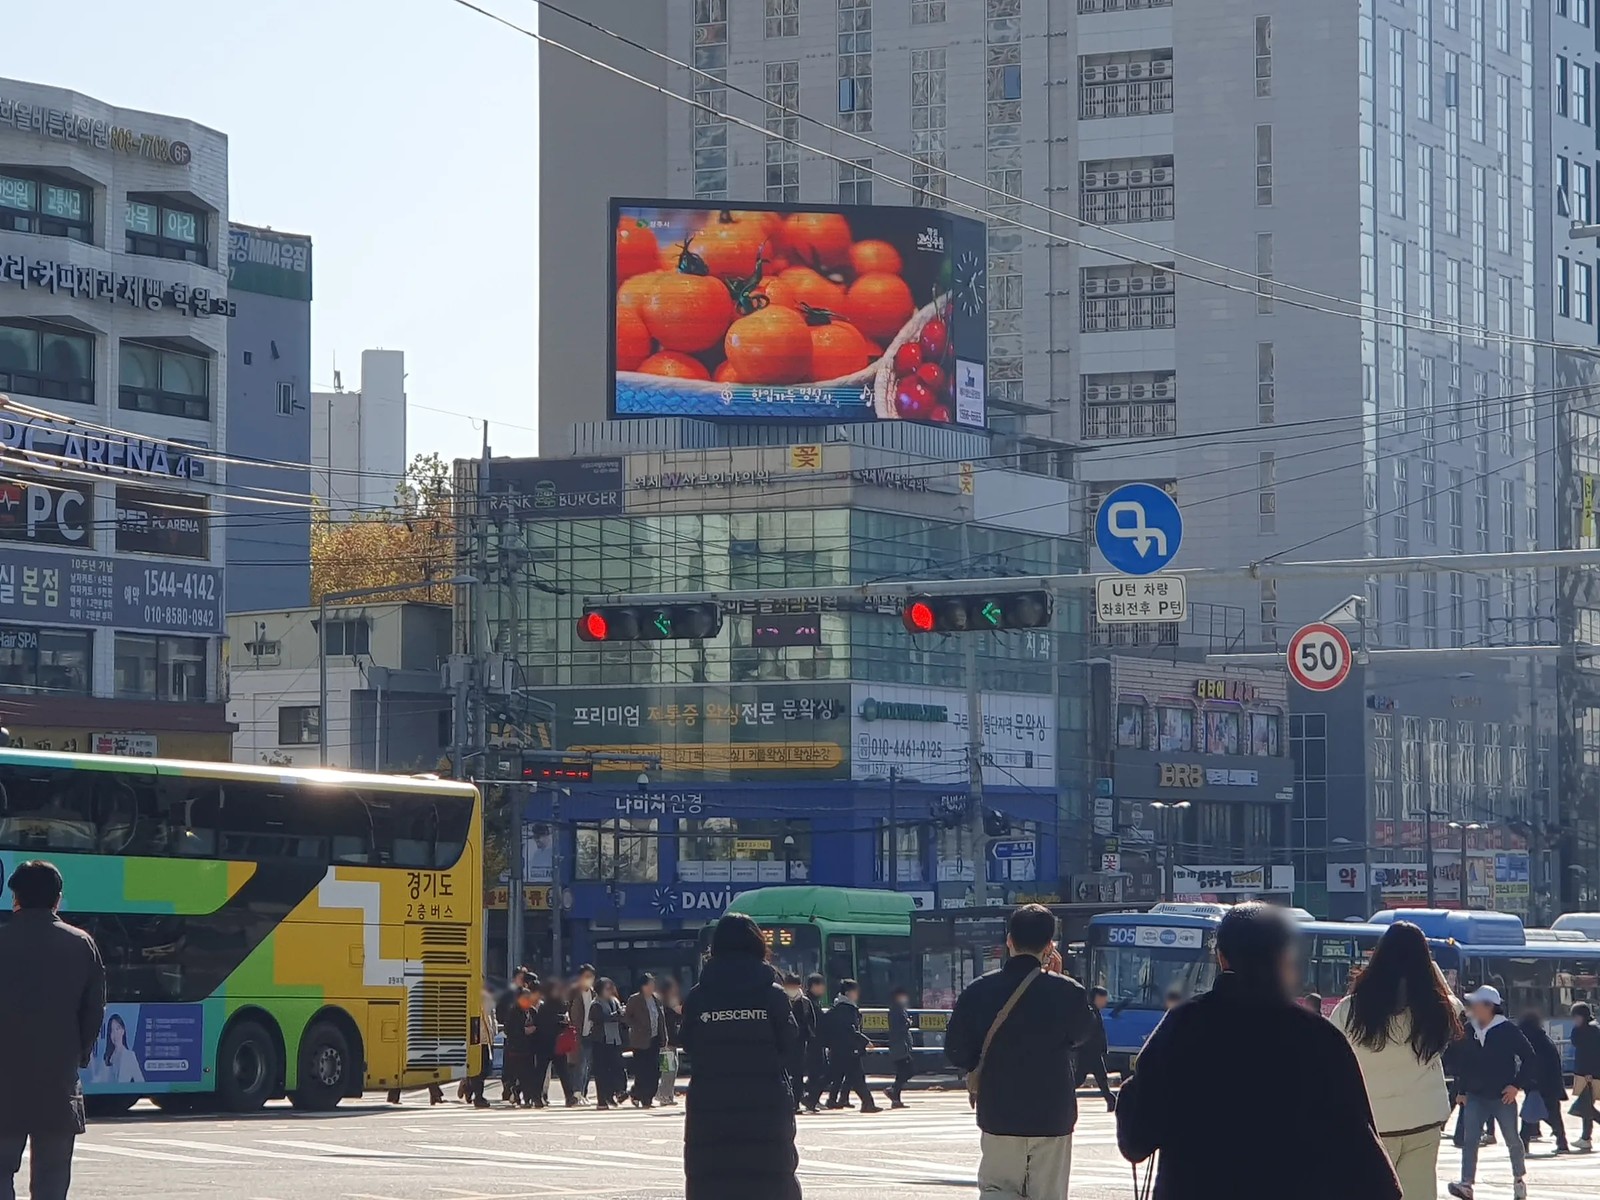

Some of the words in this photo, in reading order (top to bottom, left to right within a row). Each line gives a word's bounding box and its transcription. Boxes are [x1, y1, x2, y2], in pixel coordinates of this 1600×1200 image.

[173, 144, 188, 163] 6F
[48, 187, 81, 216] 교통사고
[168, 211, 196, 243] 야간
[64, 428, 171, 477] ARENA
[792, 445, 818, 468] 꽃
[26, 484, 86, 541] PC
[489, 493, 532, 511] RANK
[558, 491, 617, 507] BURGER
[167, 518, 200, 534] ARENA
[20, 565, 59, 608] 본점
[123, 585, 141, 606] 예약
[143, 569, 216, 601] 1544-4142
[1112, 582, 1137, 597] U턴
[1143, 582, 1169, 597] 차량
[1101, 600, 1151, 616] 좌회전후
[1158, 600, 1182, 616] P턴
[18, 631, 38, 649] SPA
[1026, 631, 1050, 660] 치과
[1301, 640, 1338, 672] 50
[573, 705, 641, 727] 프리미엄
[740, 702, 777, 725] 전문
[782, 698, 835, 720] 문왁싱
[1015, 713, 1046, 742] 문왁싱
[1160, 762, 1204, 788] BRB
[671, 792, 703, 814] 안경
[1102, 854, 1120, 871] 꽃
[406, 871, 455, 900] 경기도
[1338, 866, 1358, 889] 약
[1108, 927, 1136, 943] 505
[711, 1009, 768, 1022] DESCENTE
